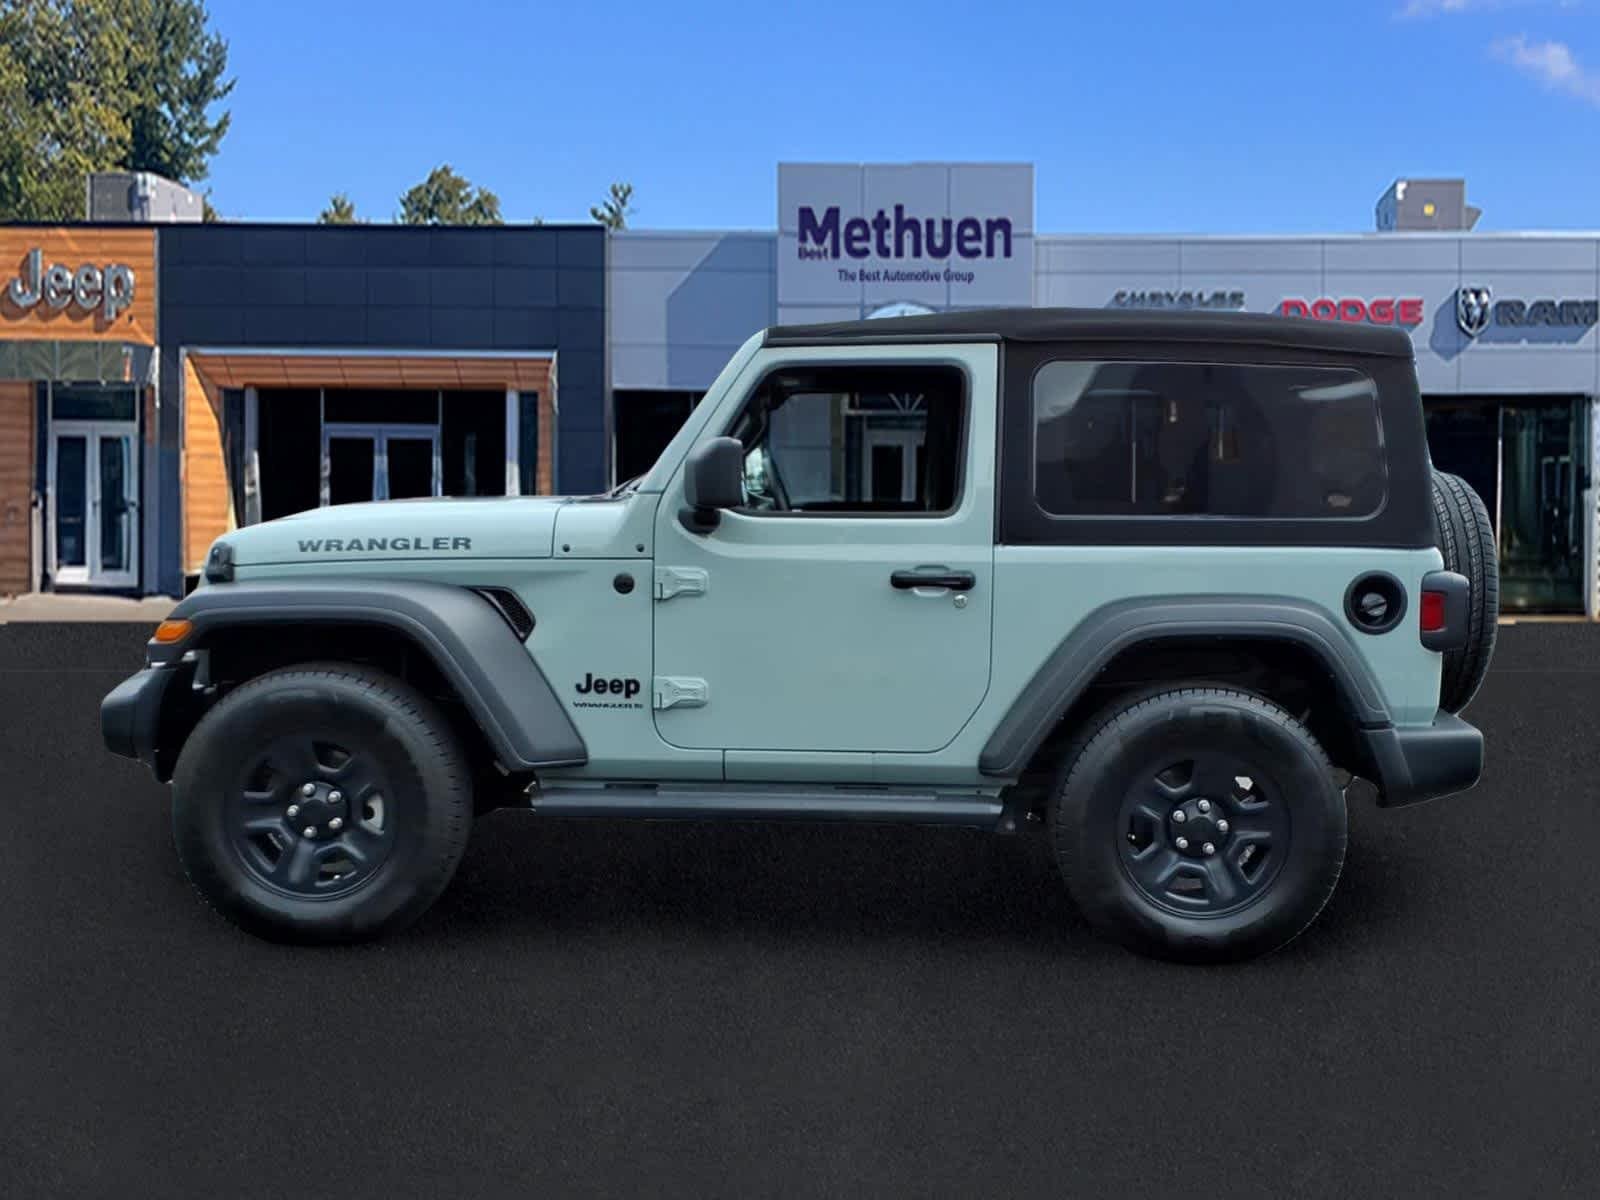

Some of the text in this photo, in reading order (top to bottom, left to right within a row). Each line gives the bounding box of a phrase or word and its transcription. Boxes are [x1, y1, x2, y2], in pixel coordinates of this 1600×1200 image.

[798, 204, 1012, 259] Methuen
[9, 248, 135, 320] Jeep
[838, 269, 975, 285] The Best Automotive Group
[1281, 299, 1423, 325] DODGE
[1495, 300, 1600, 326] RAM
[297, 536, 472, 553] WRANGLER
[575, 672, 641, 699] Jeep
